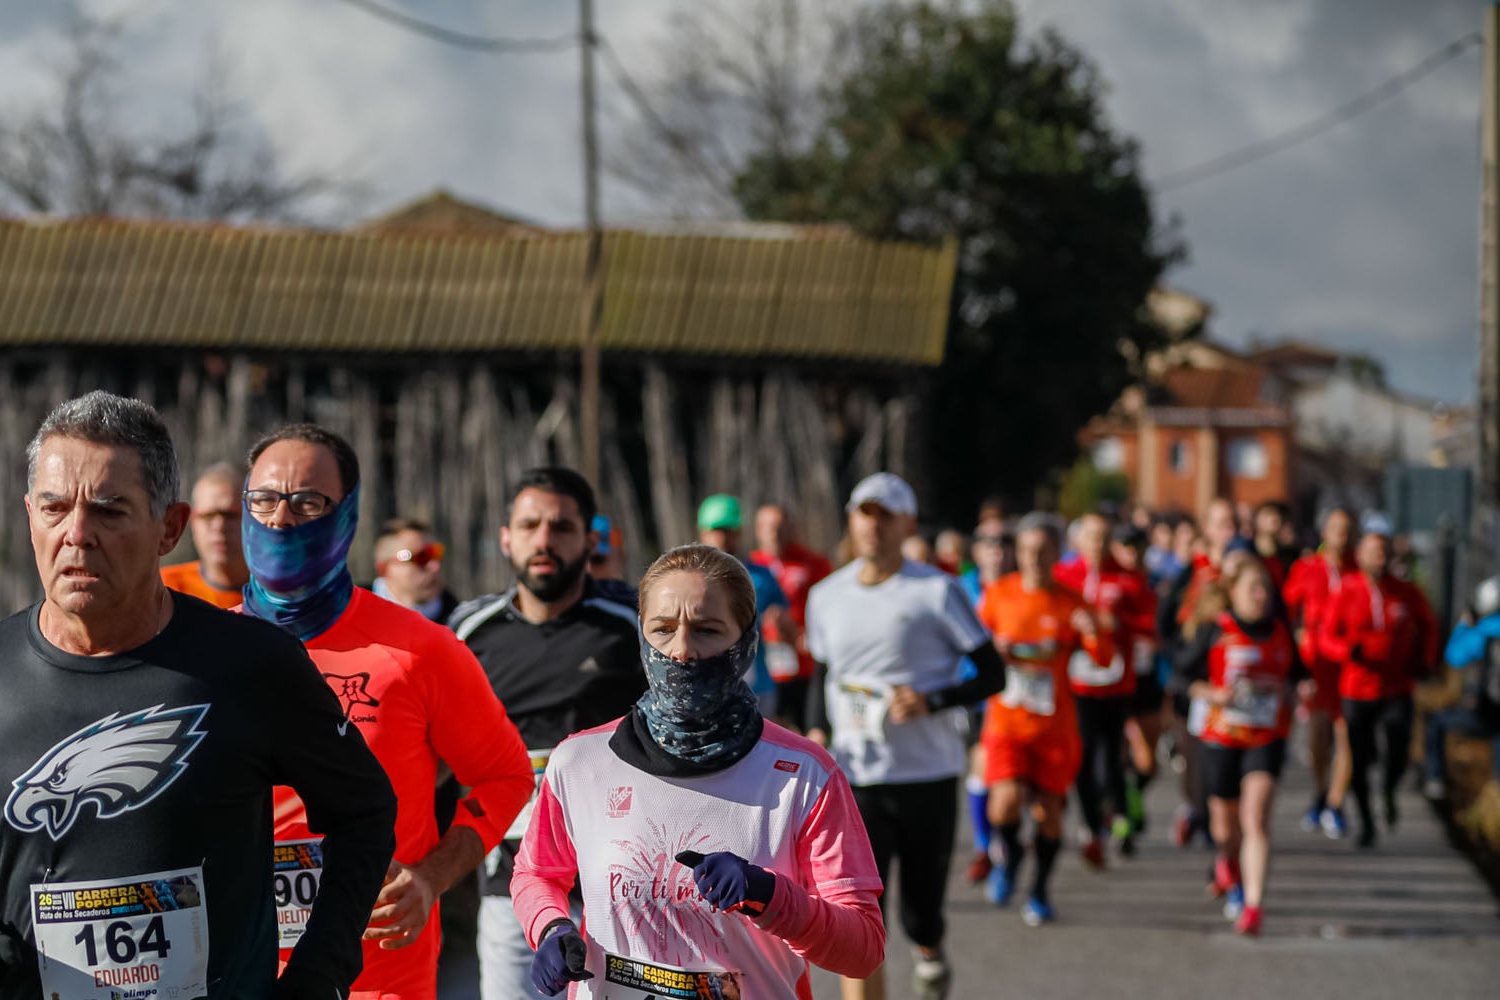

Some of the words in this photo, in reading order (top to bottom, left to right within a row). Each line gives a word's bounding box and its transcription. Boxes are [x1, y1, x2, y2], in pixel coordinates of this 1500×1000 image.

[75, 886, 137, 901] CARRERA
[609, 871, 642, 902] Por
[39, 893, 52, 906] 26
[62, 892, 75, 910] VII
[76, 896, 138, 909] POPULAR
[54, 911, 62, 919] de
[63, 910, 73, 918] los
[74, 908, 110, 918] Secaderos
[75, 916, 171, 966] 164
[610, 958, 623, 969] 26
[633, 962, 644, 979] VII
[94, 964, 159, 988] EDUARDO
[643, 974, 694, 990] POPULAR
[644, 965, 694, 983] CARRERA
[610, 972, 622, 981] Ruta
[631, 977, 639, 986] los
[640, 980, 669, 994] Secaderos
[124, 989, 157, 998] olimpo
